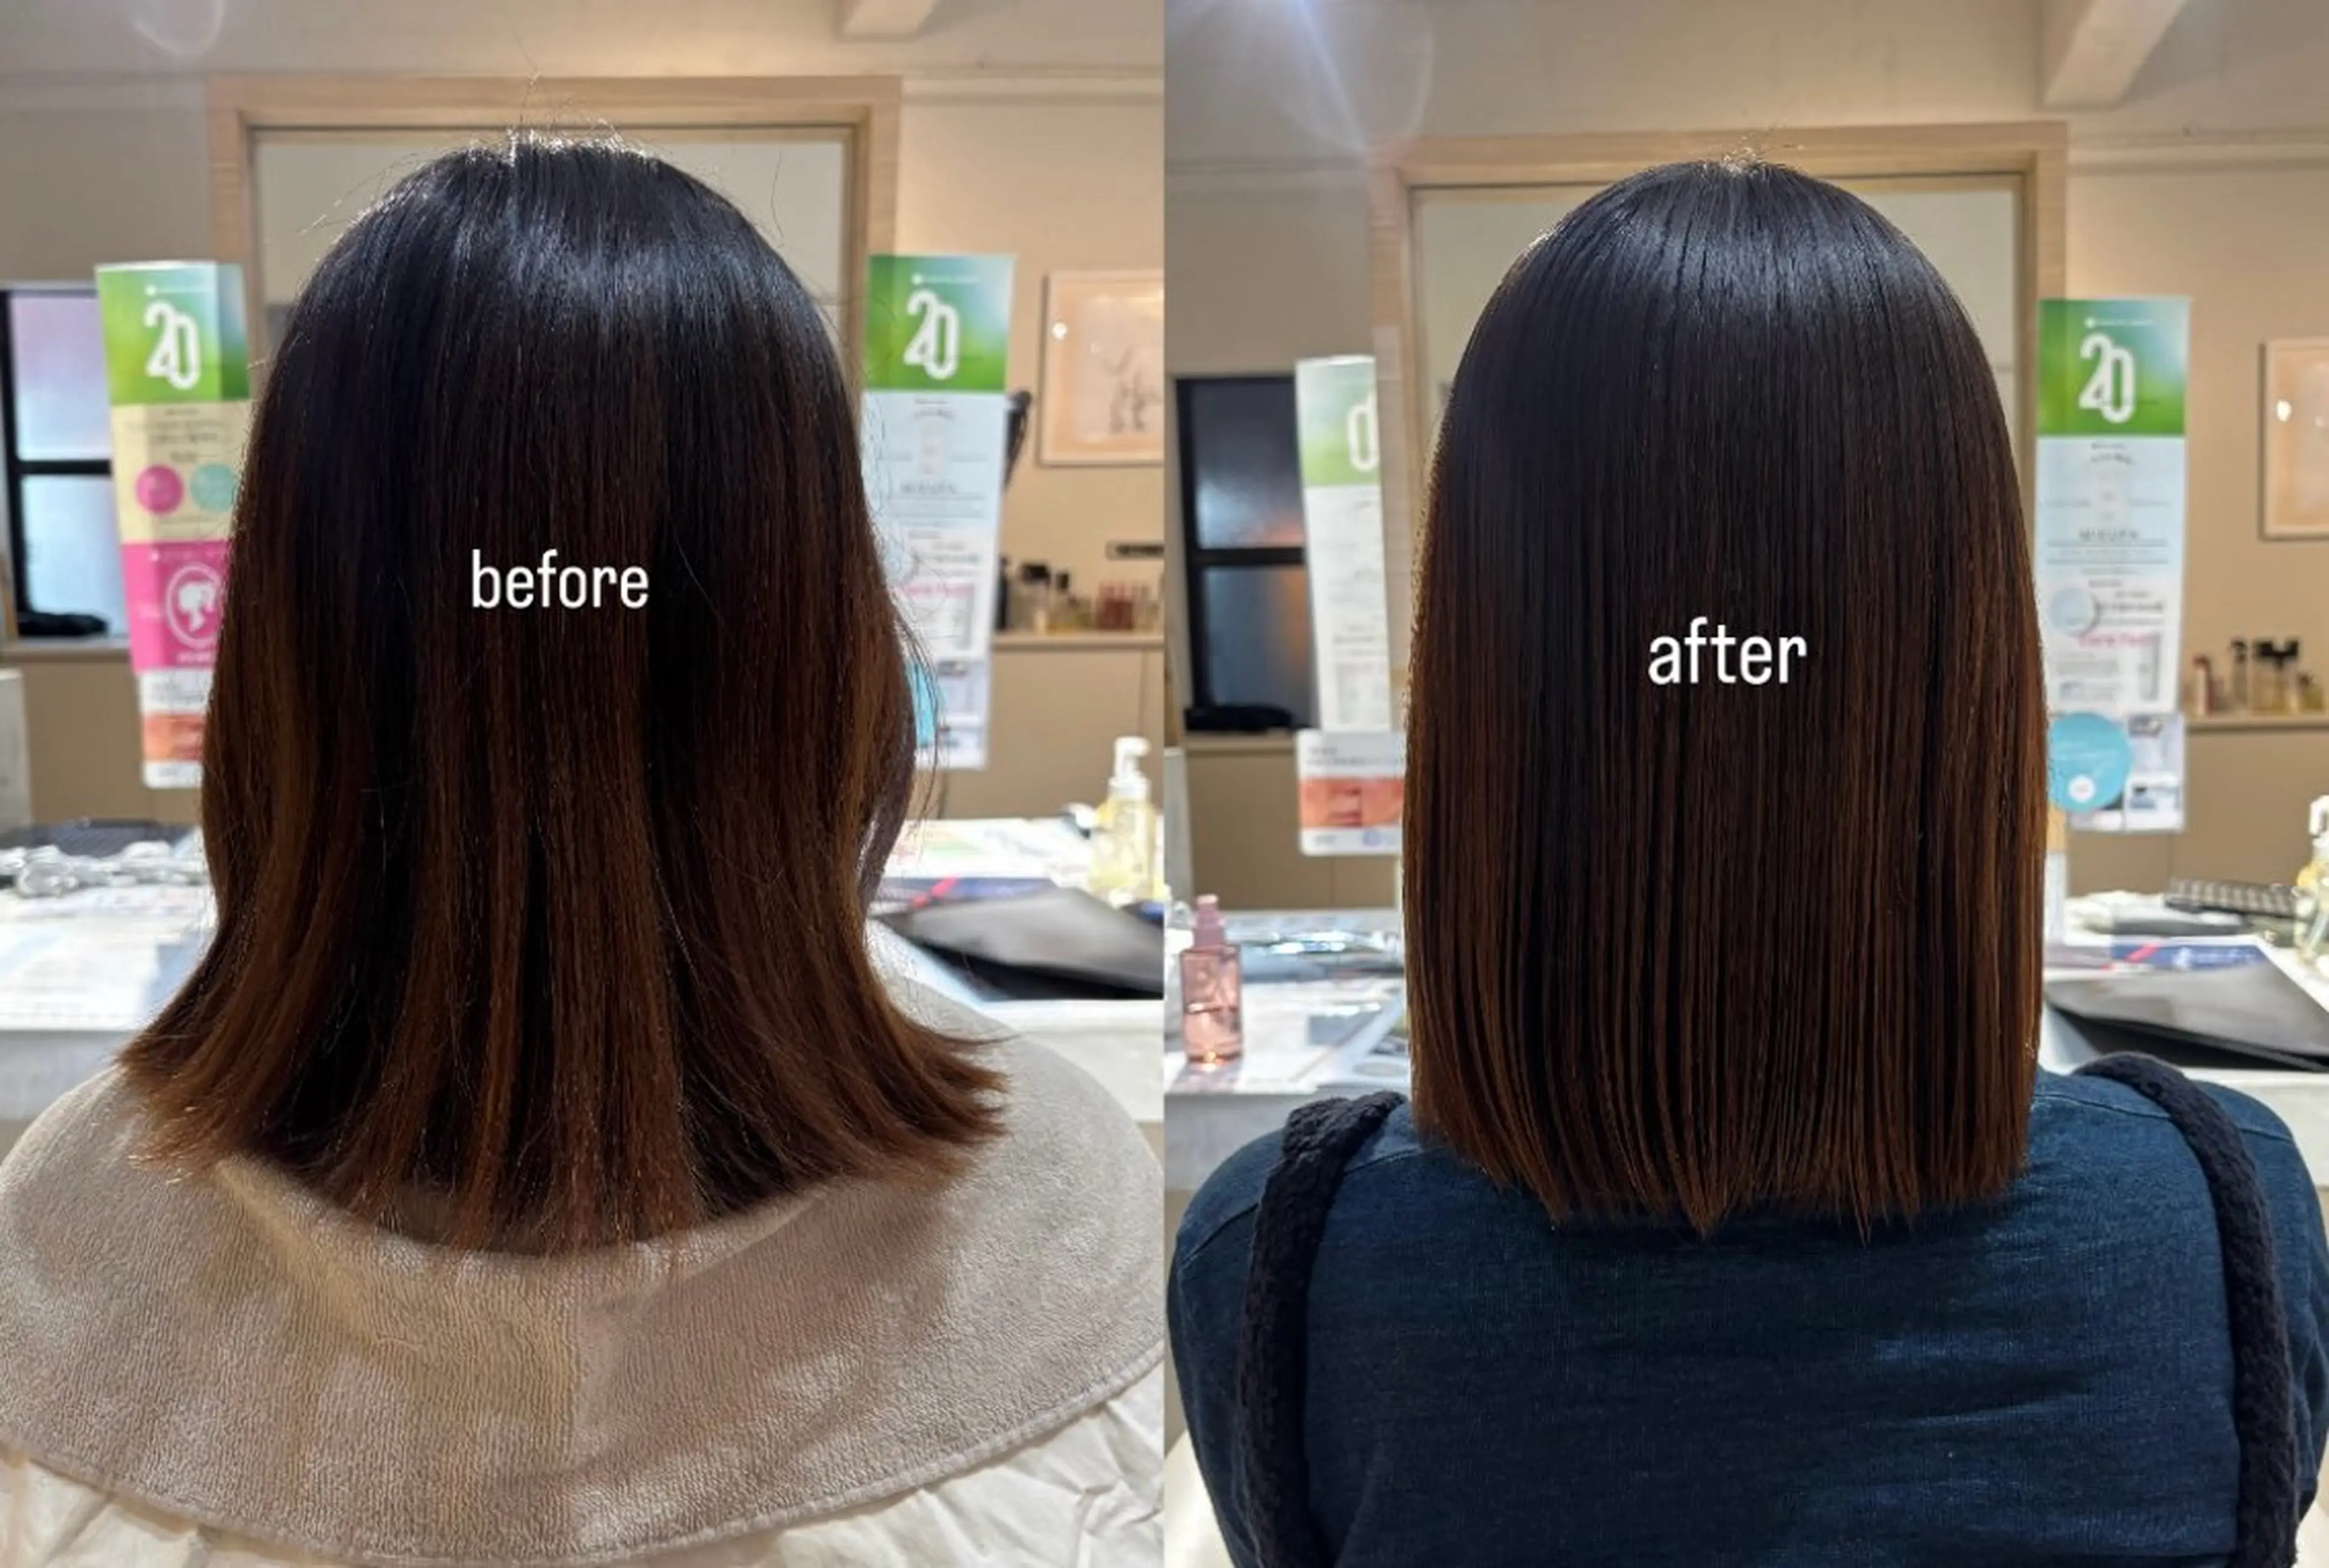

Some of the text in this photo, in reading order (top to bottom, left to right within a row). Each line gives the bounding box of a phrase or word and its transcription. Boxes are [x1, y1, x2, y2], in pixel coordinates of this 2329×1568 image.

[144, 301, 200, 389] 20
[904, 290, 959, 381] 20
[2079, 332, 2136, 424] 20
